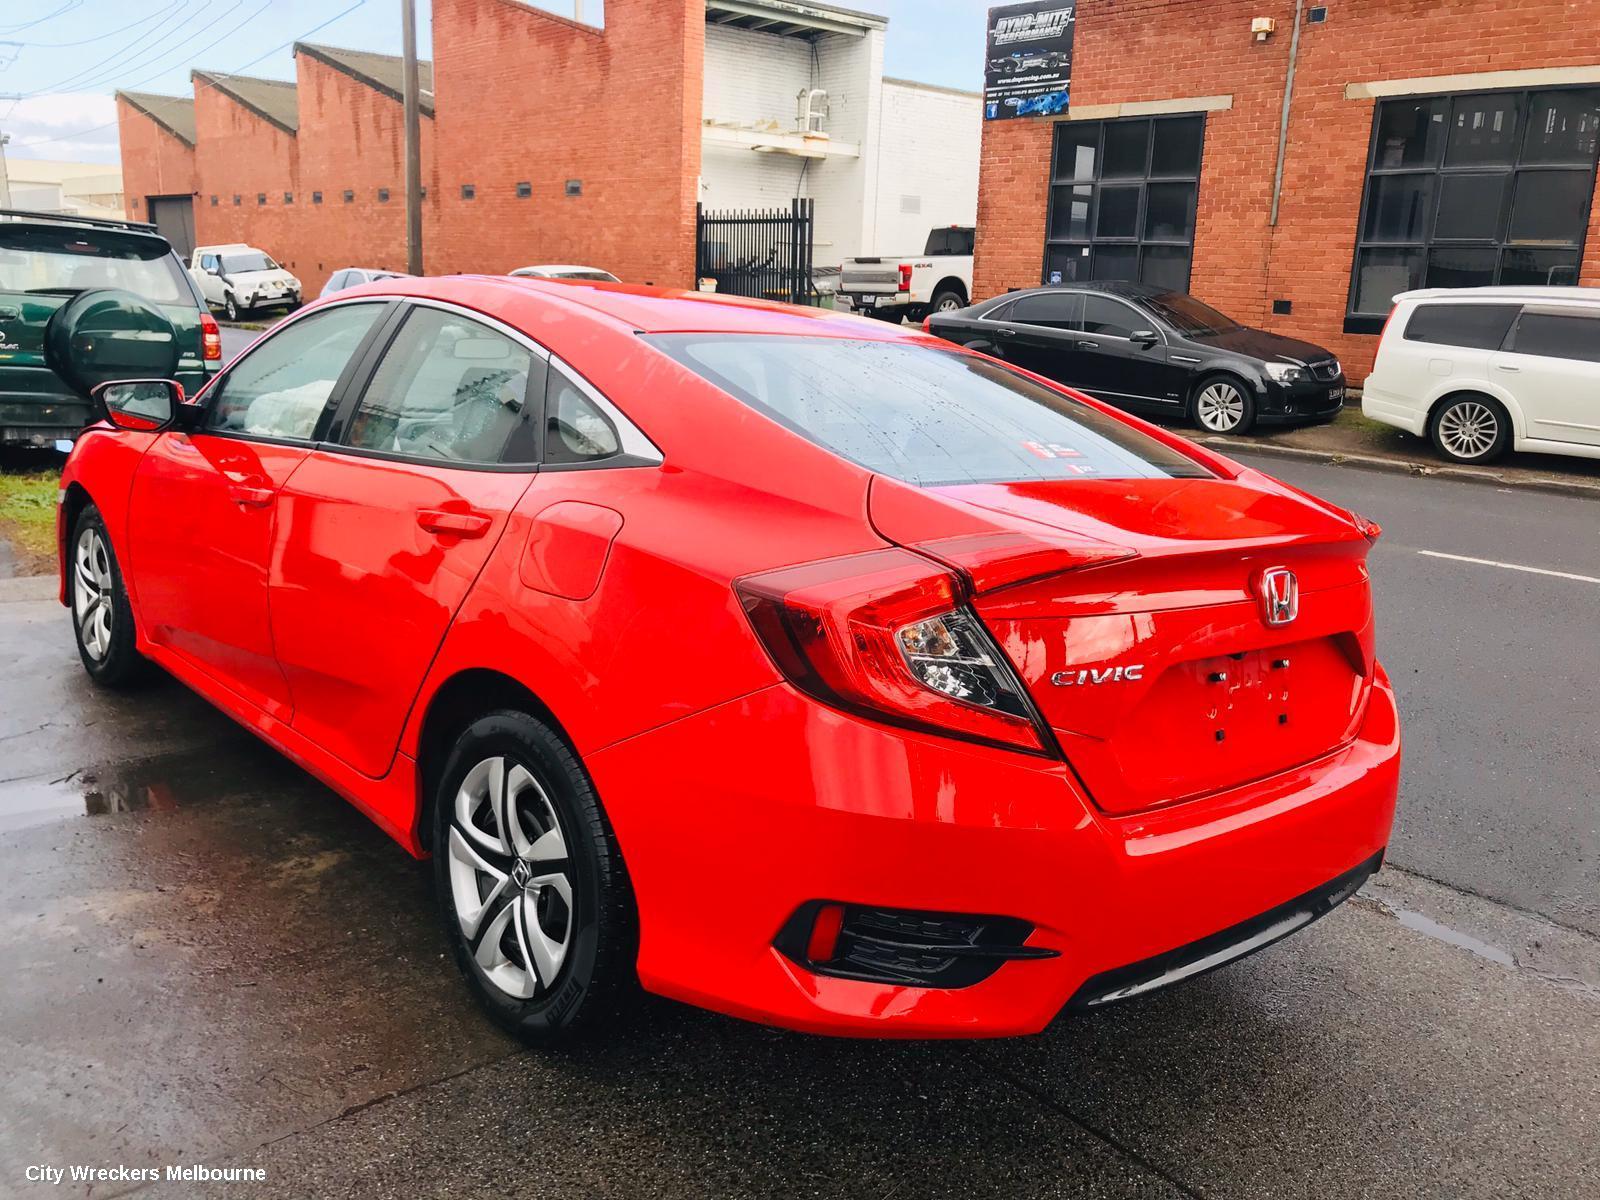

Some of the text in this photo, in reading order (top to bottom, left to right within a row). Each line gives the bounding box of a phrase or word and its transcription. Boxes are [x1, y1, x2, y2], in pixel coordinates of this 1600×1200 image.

[996, 10, 1070, 34] DYNO-MITE
[998, 25, 1063, 41] PERFORMANCE
[1051, 664, 1144, 686] CIVIC
